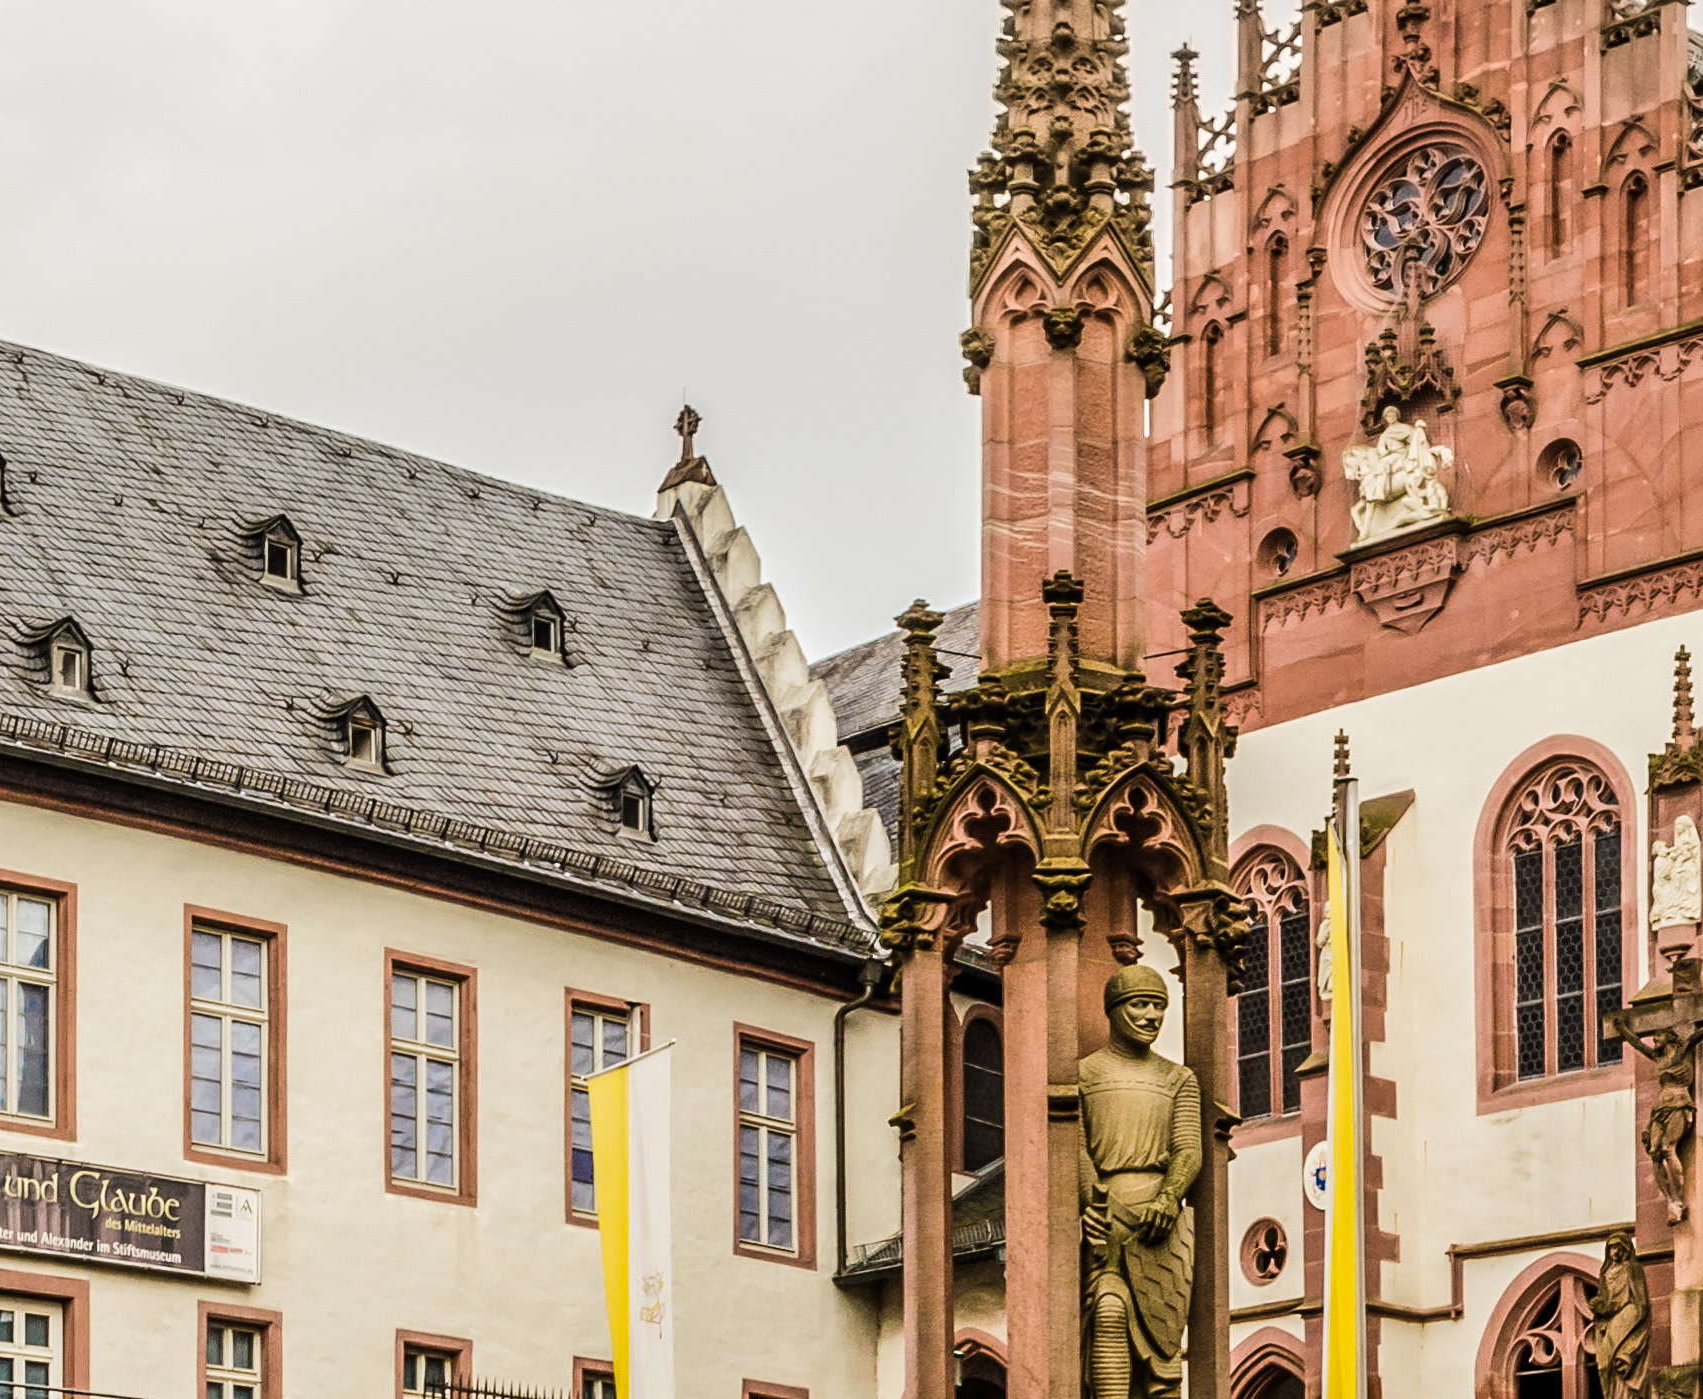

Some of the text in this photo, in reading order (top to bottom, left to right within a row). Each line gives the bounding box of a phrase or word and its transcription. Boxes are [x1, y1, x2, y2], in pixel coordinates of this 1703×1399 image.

[4, 1172, 59, 1204] und
[69, 1170, 181, 1221] Glaube
[105, 1217, 182, 1240] des Mittelalters
[16, 1229, 38, 1244] und
[41, 1230, 94, 1252] Alexander
[96, 1238, 111, 1254] im
[112, 1241, 182, 1264] Stiftsmuseum
